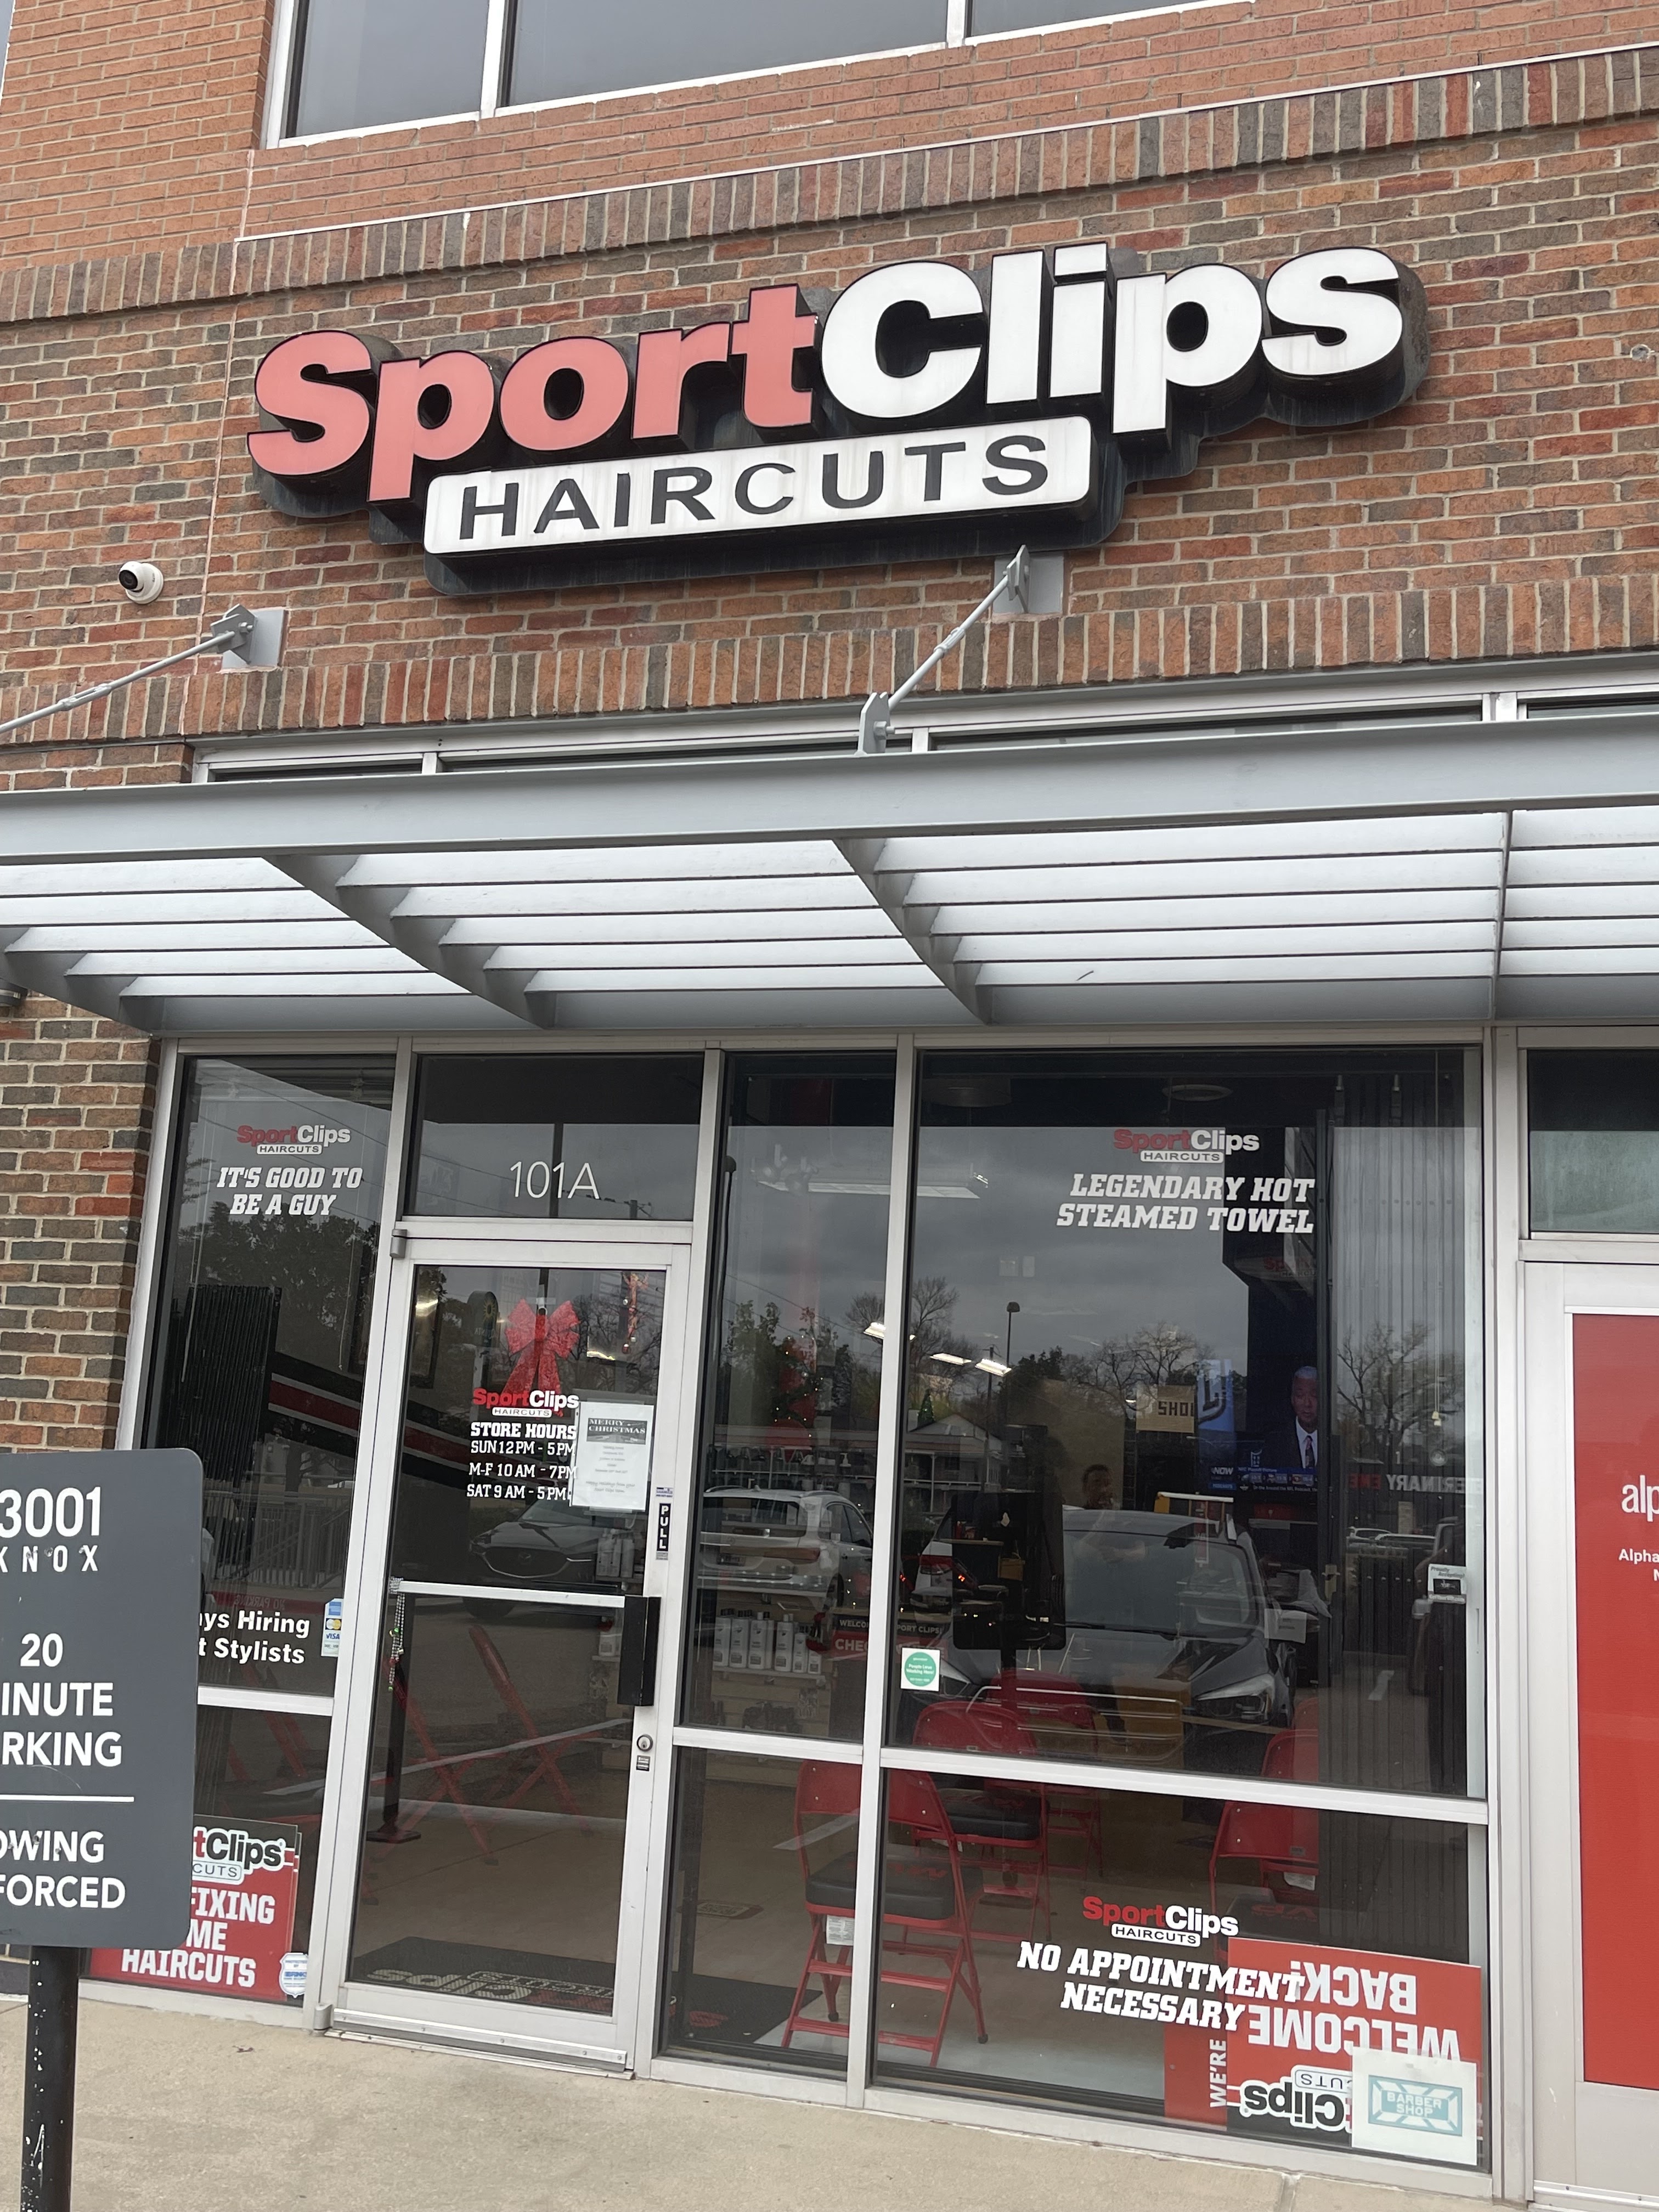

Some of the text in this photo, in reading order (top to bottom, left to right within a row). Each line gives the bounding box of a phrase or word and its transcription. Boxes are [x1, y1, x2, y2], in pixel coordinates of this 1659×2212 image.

[460, 436, 1048, 539] HAIRCUTS
[259, 1145, 319, 1153] HAIRCUTS
[1143, 1152, 1220, 1161] HAIRCUTS
[217, 1167, 363, 1188] IT'S GOOD TO
[510, 1160, 600, 1199] 101A
[1070, 1173, 1316, 1202] LEGENDARY HOT
[229, 1194, 336, 1215] BE A GUY
[1056, 1204, 1314, 1233] STEAMED TOWEL
[471, 1422, 577, 1440] STORE HOURS
[469, 1463, 493, 1476] M-F
[0, 1487, 101, 1538] 3001
[1621, 1475, 1659, 1522] alp
[659, 1505, 669, 1549] PULL
[199, 1610, 310, 1639] ys Hiring
[839, 1620, 868, 1628] WELCO
[20, 1633, 64, 1667] 20
[214, 1637, 305, 1664] Stylists
[2, 1682, 114, 1717] INUTE
[2, 1731, 122, 1767] RKING
[191, 1887, 275, 1925] IXING
[1115, 1926, 1197, 1944] HAIRCUTS
[121, 1949, 257, 1988] HAIRCUTS
[1017, 1941, 1306, 2002] NO APPOINTMENT
[1060, 1981, 1246, 2031] NECESSARY
[1248, 2005, 1461, 2062] WELCOME
[1210, 2038, 1227, 2108] WE'RE
[1387, 2092, 1442, 2109] BARBER
[1396, 2104, 1434, 2117] SHOP
